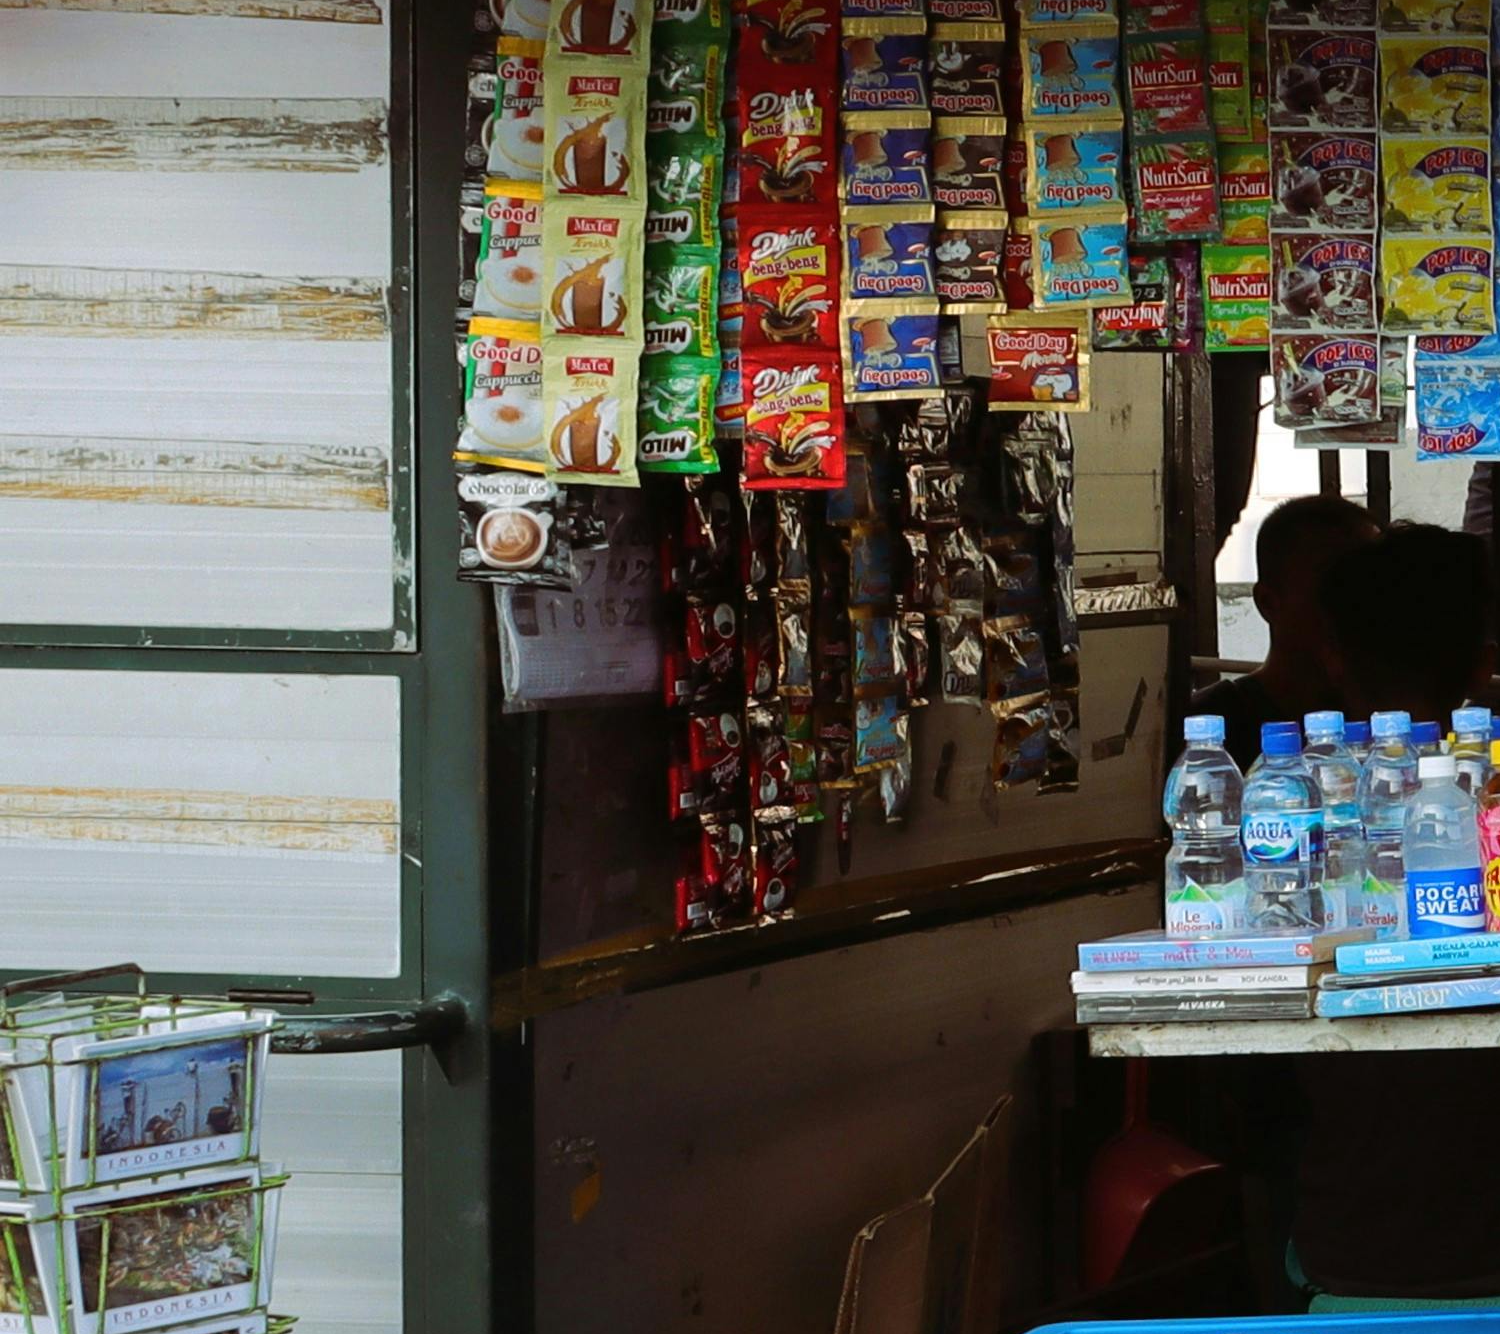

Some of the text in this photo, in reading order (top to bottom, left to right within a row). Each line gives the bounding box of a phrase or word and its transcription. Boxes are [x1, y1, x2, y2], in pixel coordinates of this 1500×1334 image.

[1133, 66, 1197, 87] NutriSari
[1142, 163, 1211, 188] NutriSari
[566, 217, 620, 238] MaxTea
[751, 228, 816, 256] Drink
[751, 254, 818, 275] beng-beng
[565, 356, 615, 375] MaxTea
[1316, 346, 1345, 365] POP
[755, 363, 819, 393] Drink
[753, 390, 822, 413] beng-beng
[641, 431, 687, 454] MILO
[1245, 820, 1293, 841] AQUA
[1416, 899, 1480, 915] SWEAT
[1177, 1000, 1226, 1011] ALVASKA
[108, 1140, 226, 1169] INDONESIA
[113, 1291, 234, 1324] INDONESIA
